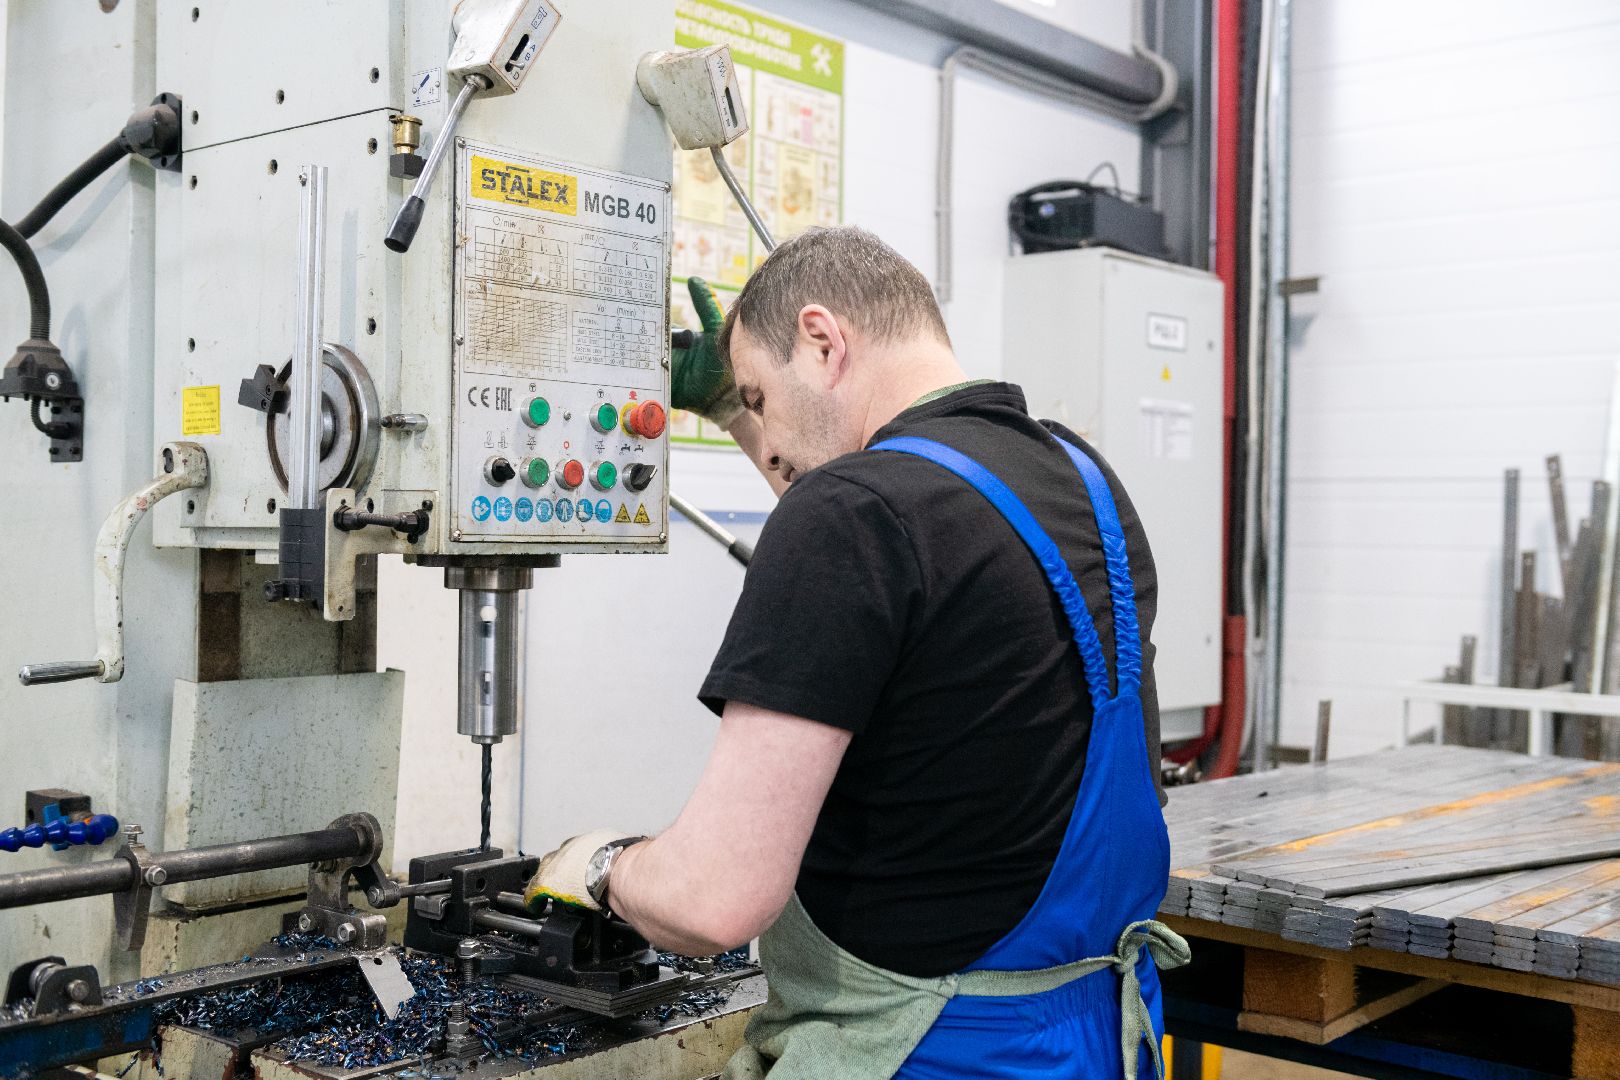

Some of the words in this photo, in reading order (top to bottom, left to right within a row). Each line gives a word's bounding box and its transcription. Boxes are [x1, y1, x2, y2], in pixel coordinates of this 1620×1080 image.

[481, 168, 569, 205] STALEX
[584, 190, 631, 219] MGB
[635, 202, 656, 225] 40
